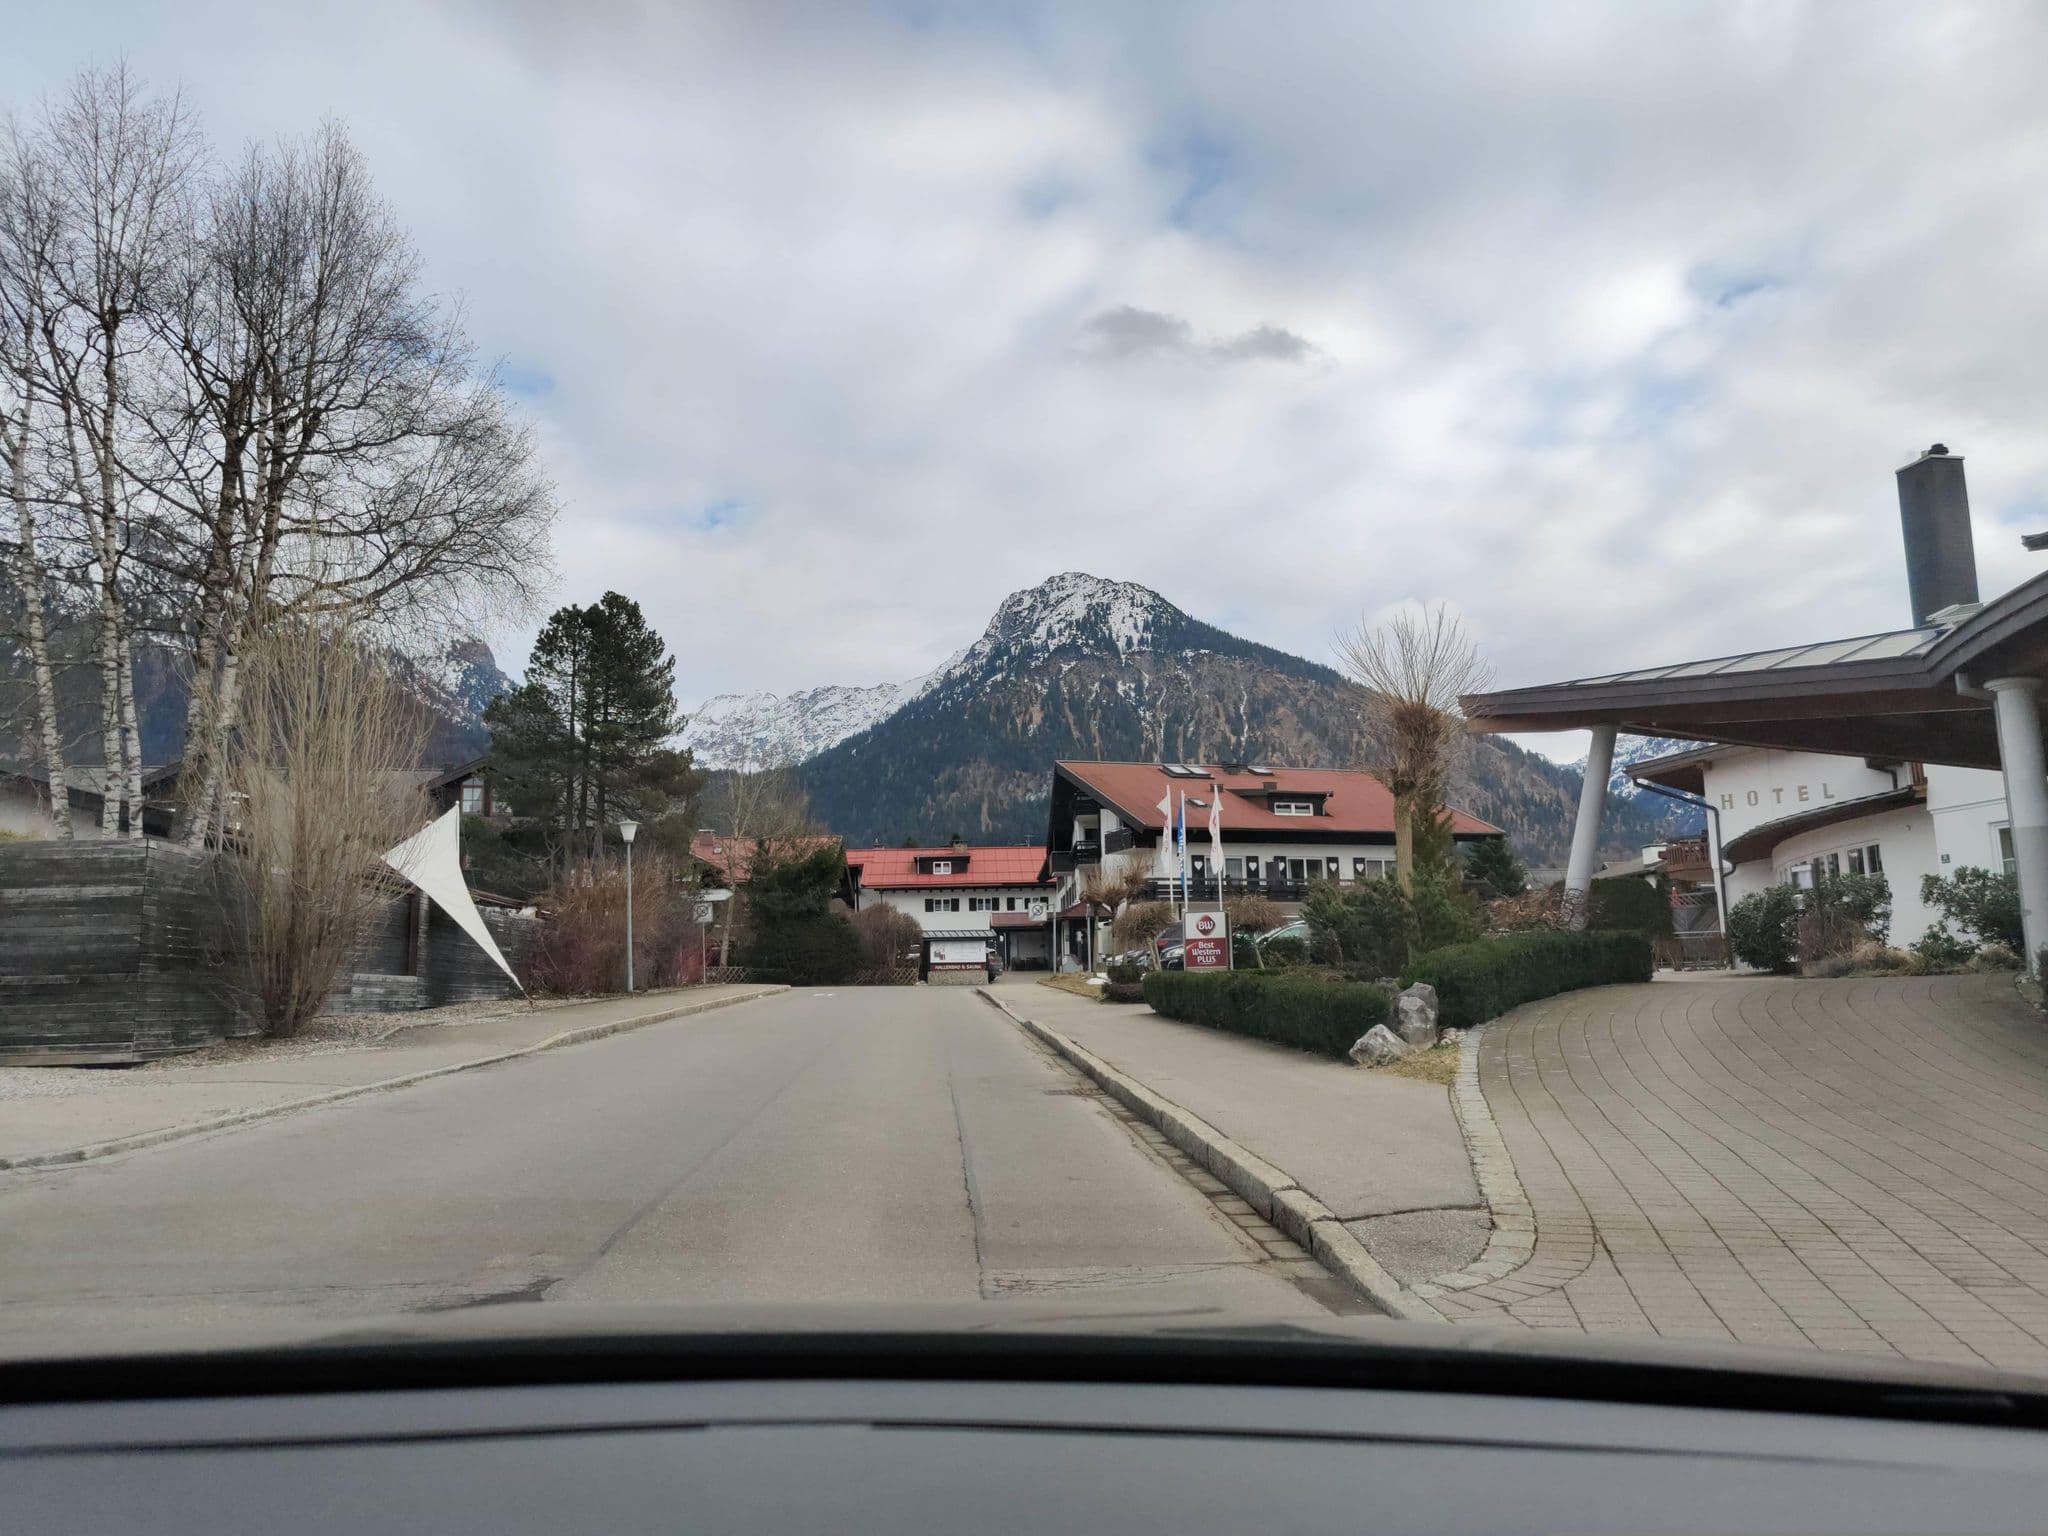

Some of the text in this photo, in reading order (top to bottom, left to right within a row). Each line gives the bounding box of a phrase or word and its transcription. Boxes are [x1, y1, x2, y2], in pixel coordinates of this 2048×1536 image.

[1720, 783, 1835, 810] HOTEL
[1199, 921, 1213, 930] BW
[1198, 941, 1214, 949] Best
[1192, 948, 1221, 956] Western
